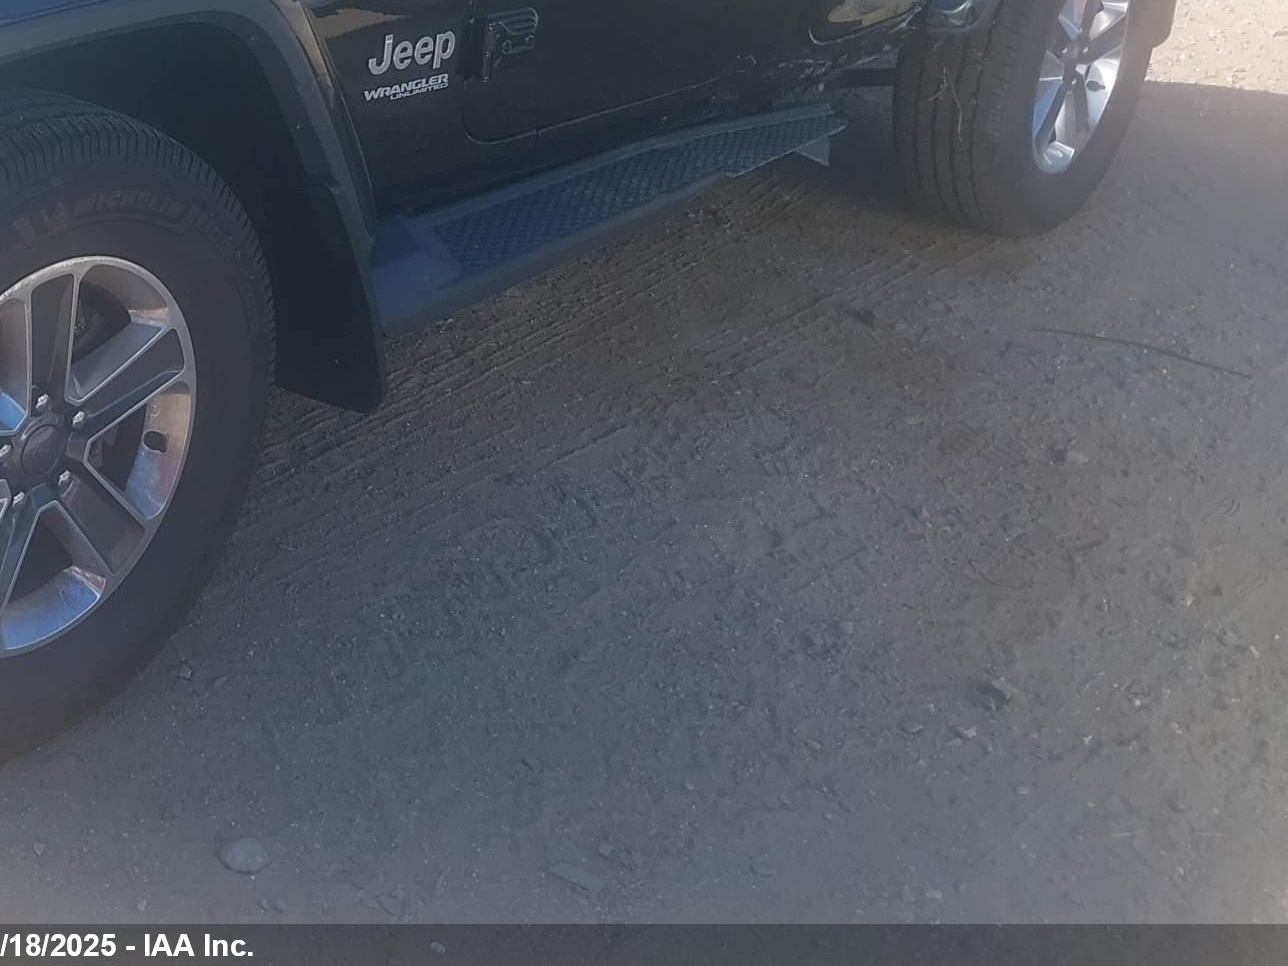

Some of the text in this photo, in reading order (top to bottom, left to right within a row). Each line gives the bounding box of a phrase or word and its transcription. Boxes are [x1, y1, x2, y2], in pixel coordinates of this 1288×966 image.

[368, 30, 456, 75] Jeep
[363, 73, 449, 101] WRANGLER
[389, 82, 449, 101] UNLIMITED
